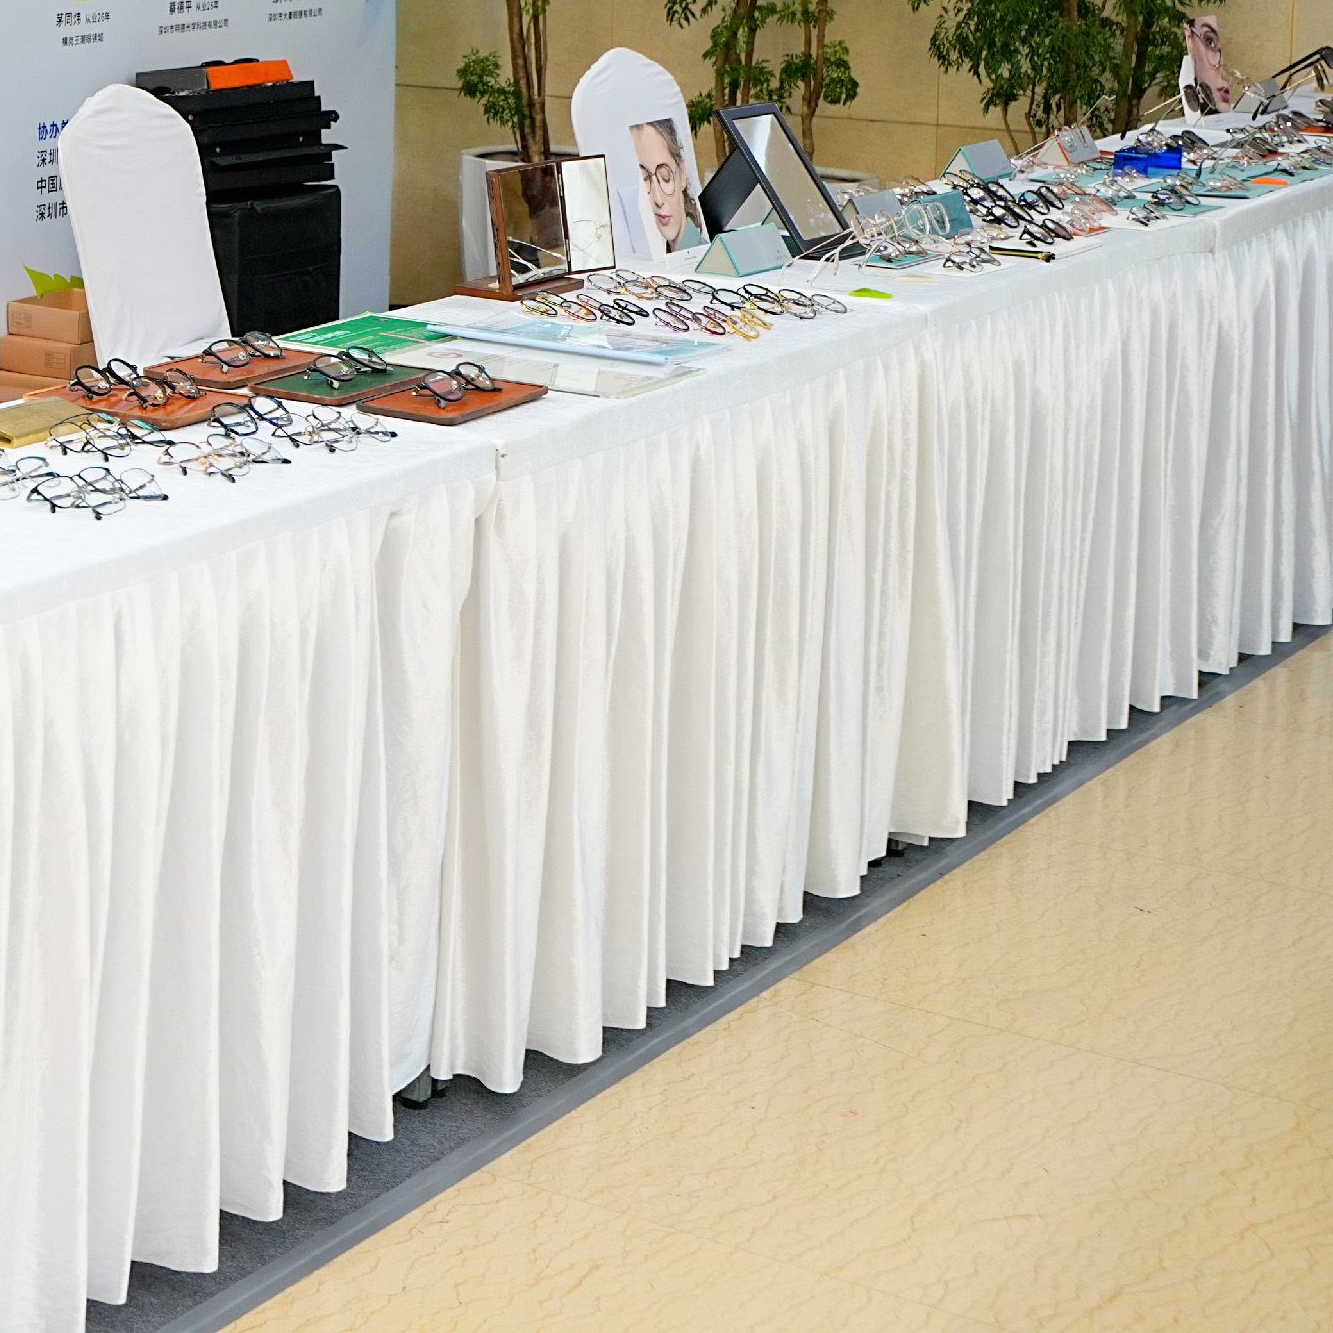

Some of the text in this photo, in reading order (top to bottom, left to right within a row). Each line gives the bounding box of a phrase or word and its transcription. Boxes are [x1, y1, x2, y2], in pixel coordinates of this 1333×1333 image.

[37, 176, 63, 195] 中国
[35, 201, 68, 222] 深圳市
